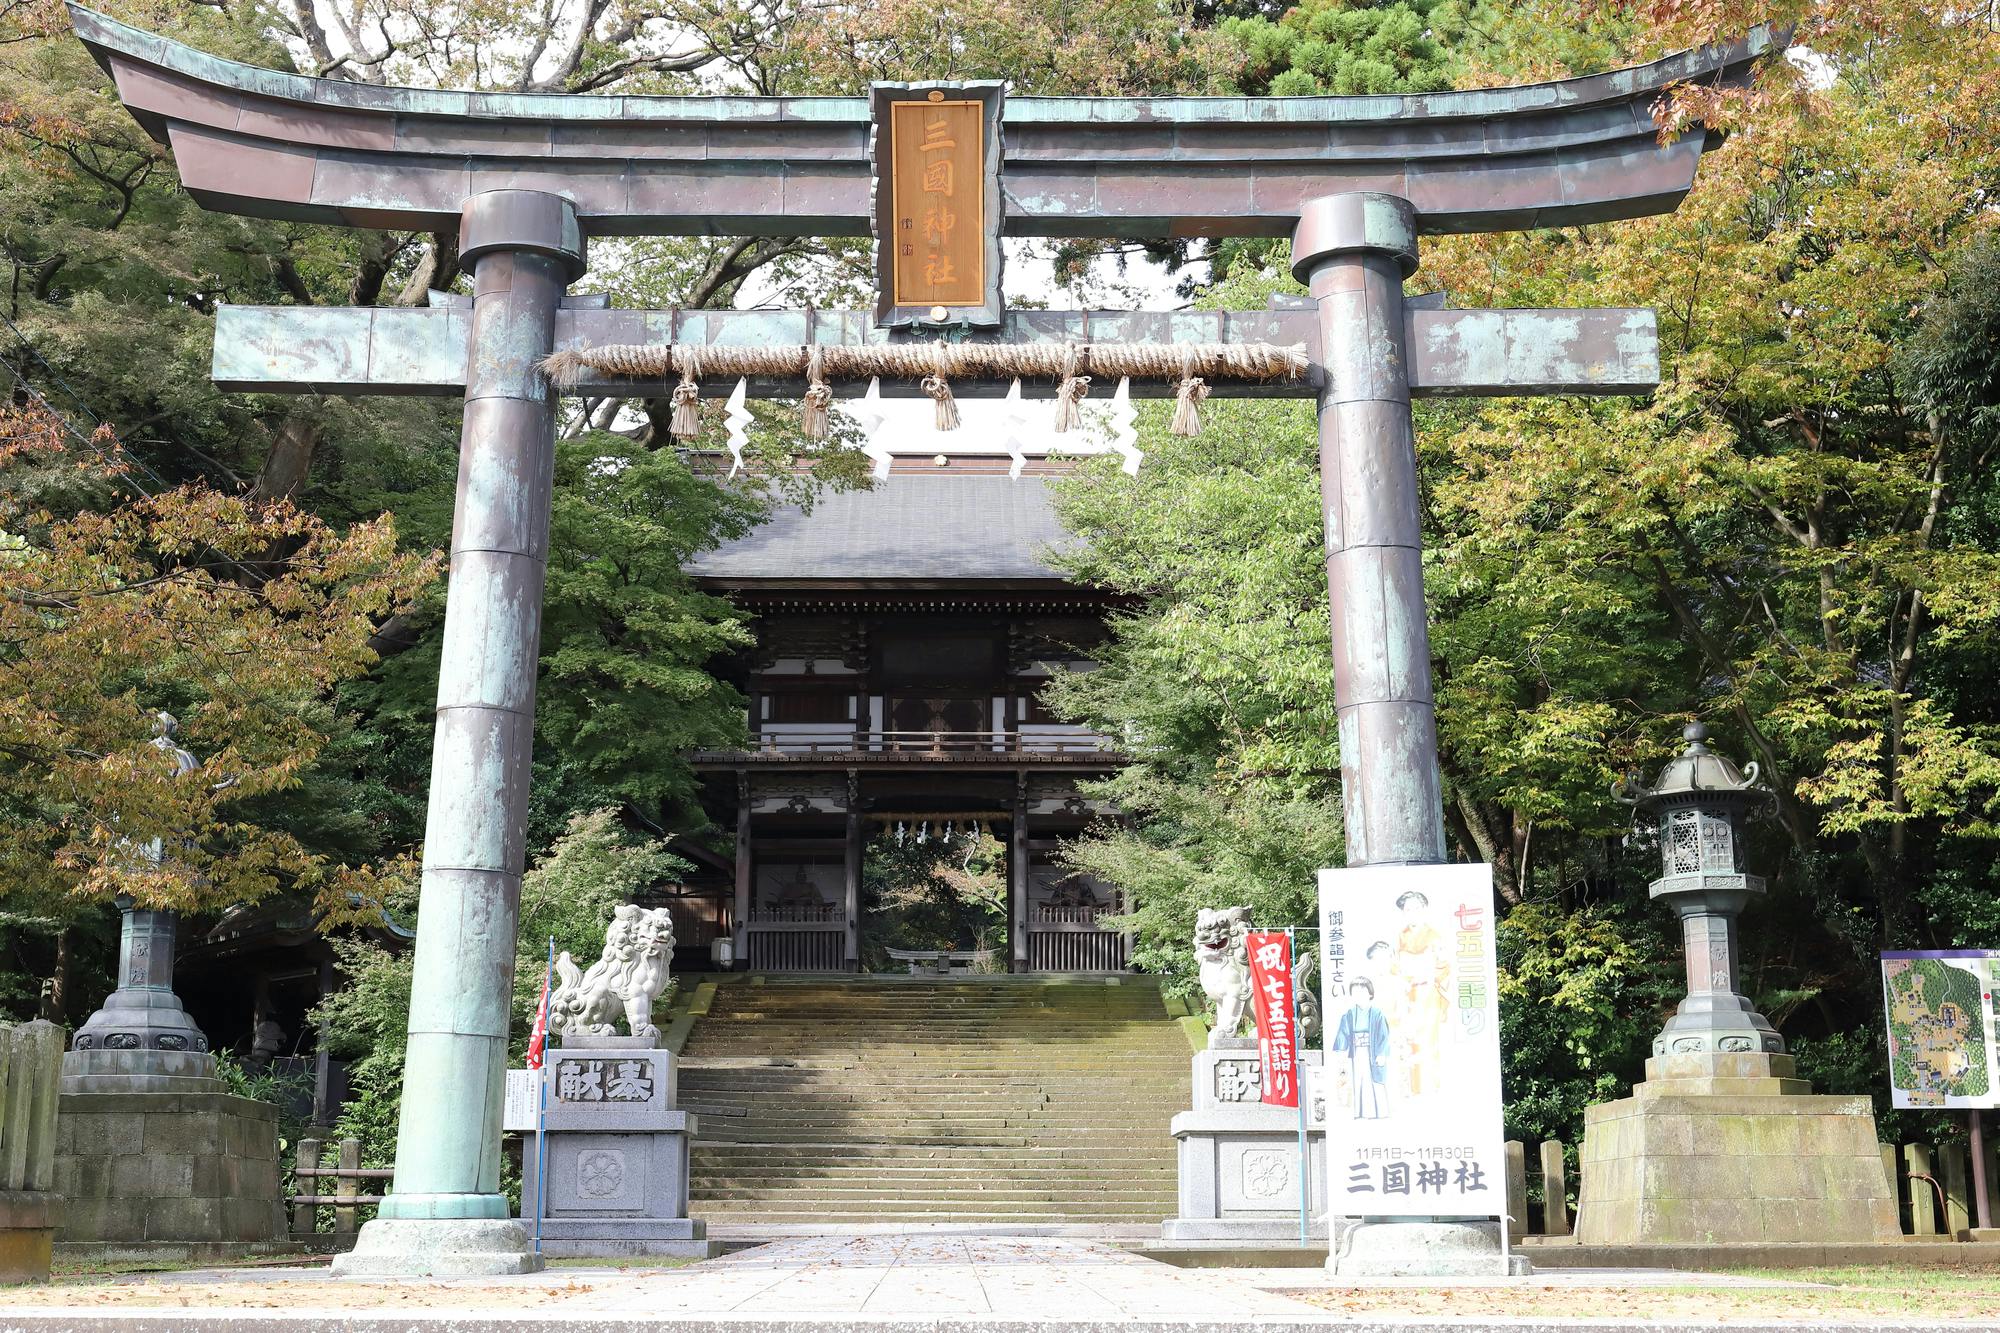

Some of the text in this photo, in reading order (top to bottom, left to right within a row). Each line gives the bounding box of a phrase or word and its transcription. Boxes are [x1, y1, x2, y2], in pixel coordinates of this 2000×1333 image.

[1328, 910, 1345, 998] 御参詣下さい
[1454, 903, 1487, 1036] 七五三詣り
[1346, 1160, 1488, 1196] 三国神社
